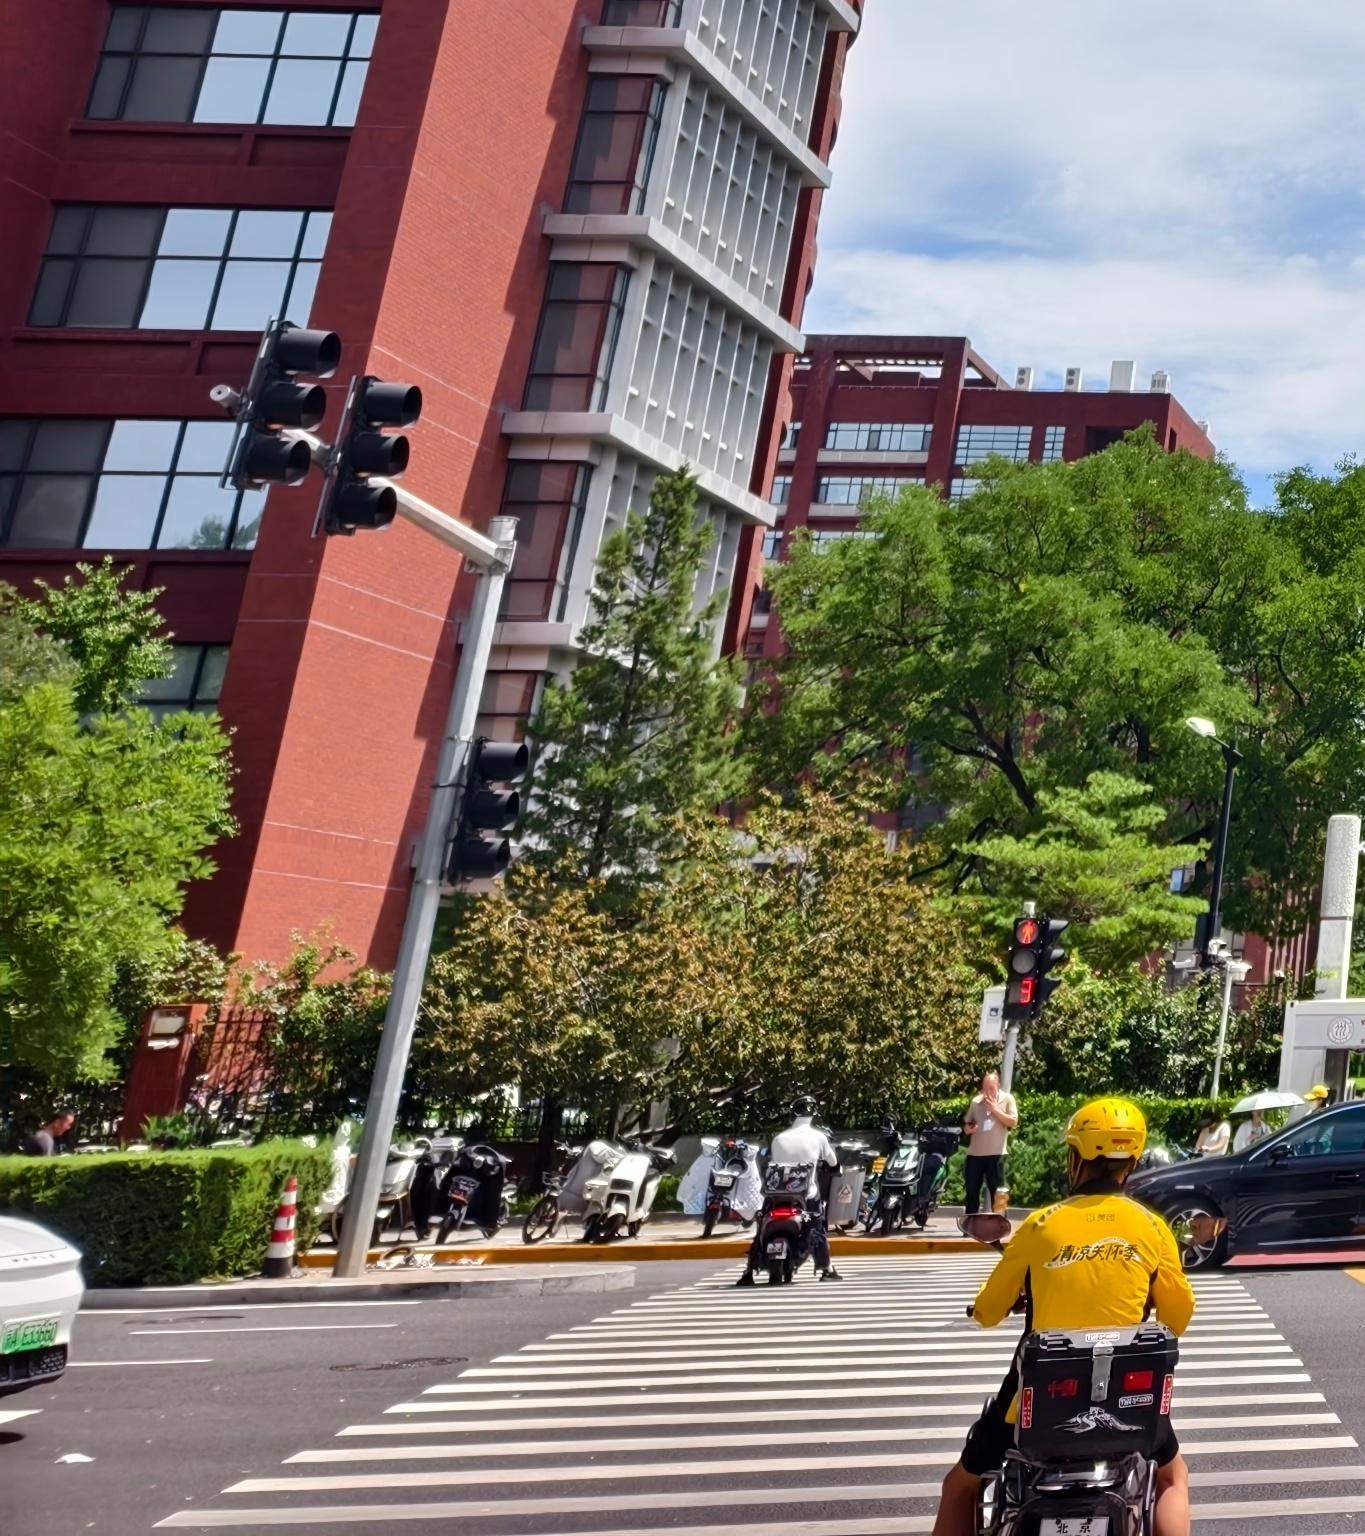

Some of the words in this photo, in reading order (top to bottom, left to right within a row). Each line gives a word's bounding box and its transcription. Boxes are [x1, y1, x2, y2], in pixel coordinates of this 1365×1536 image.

[1052, 1244, 1139, 1262] 清凉关怀季
[1056, 1523, 1091, 1534] 北京
